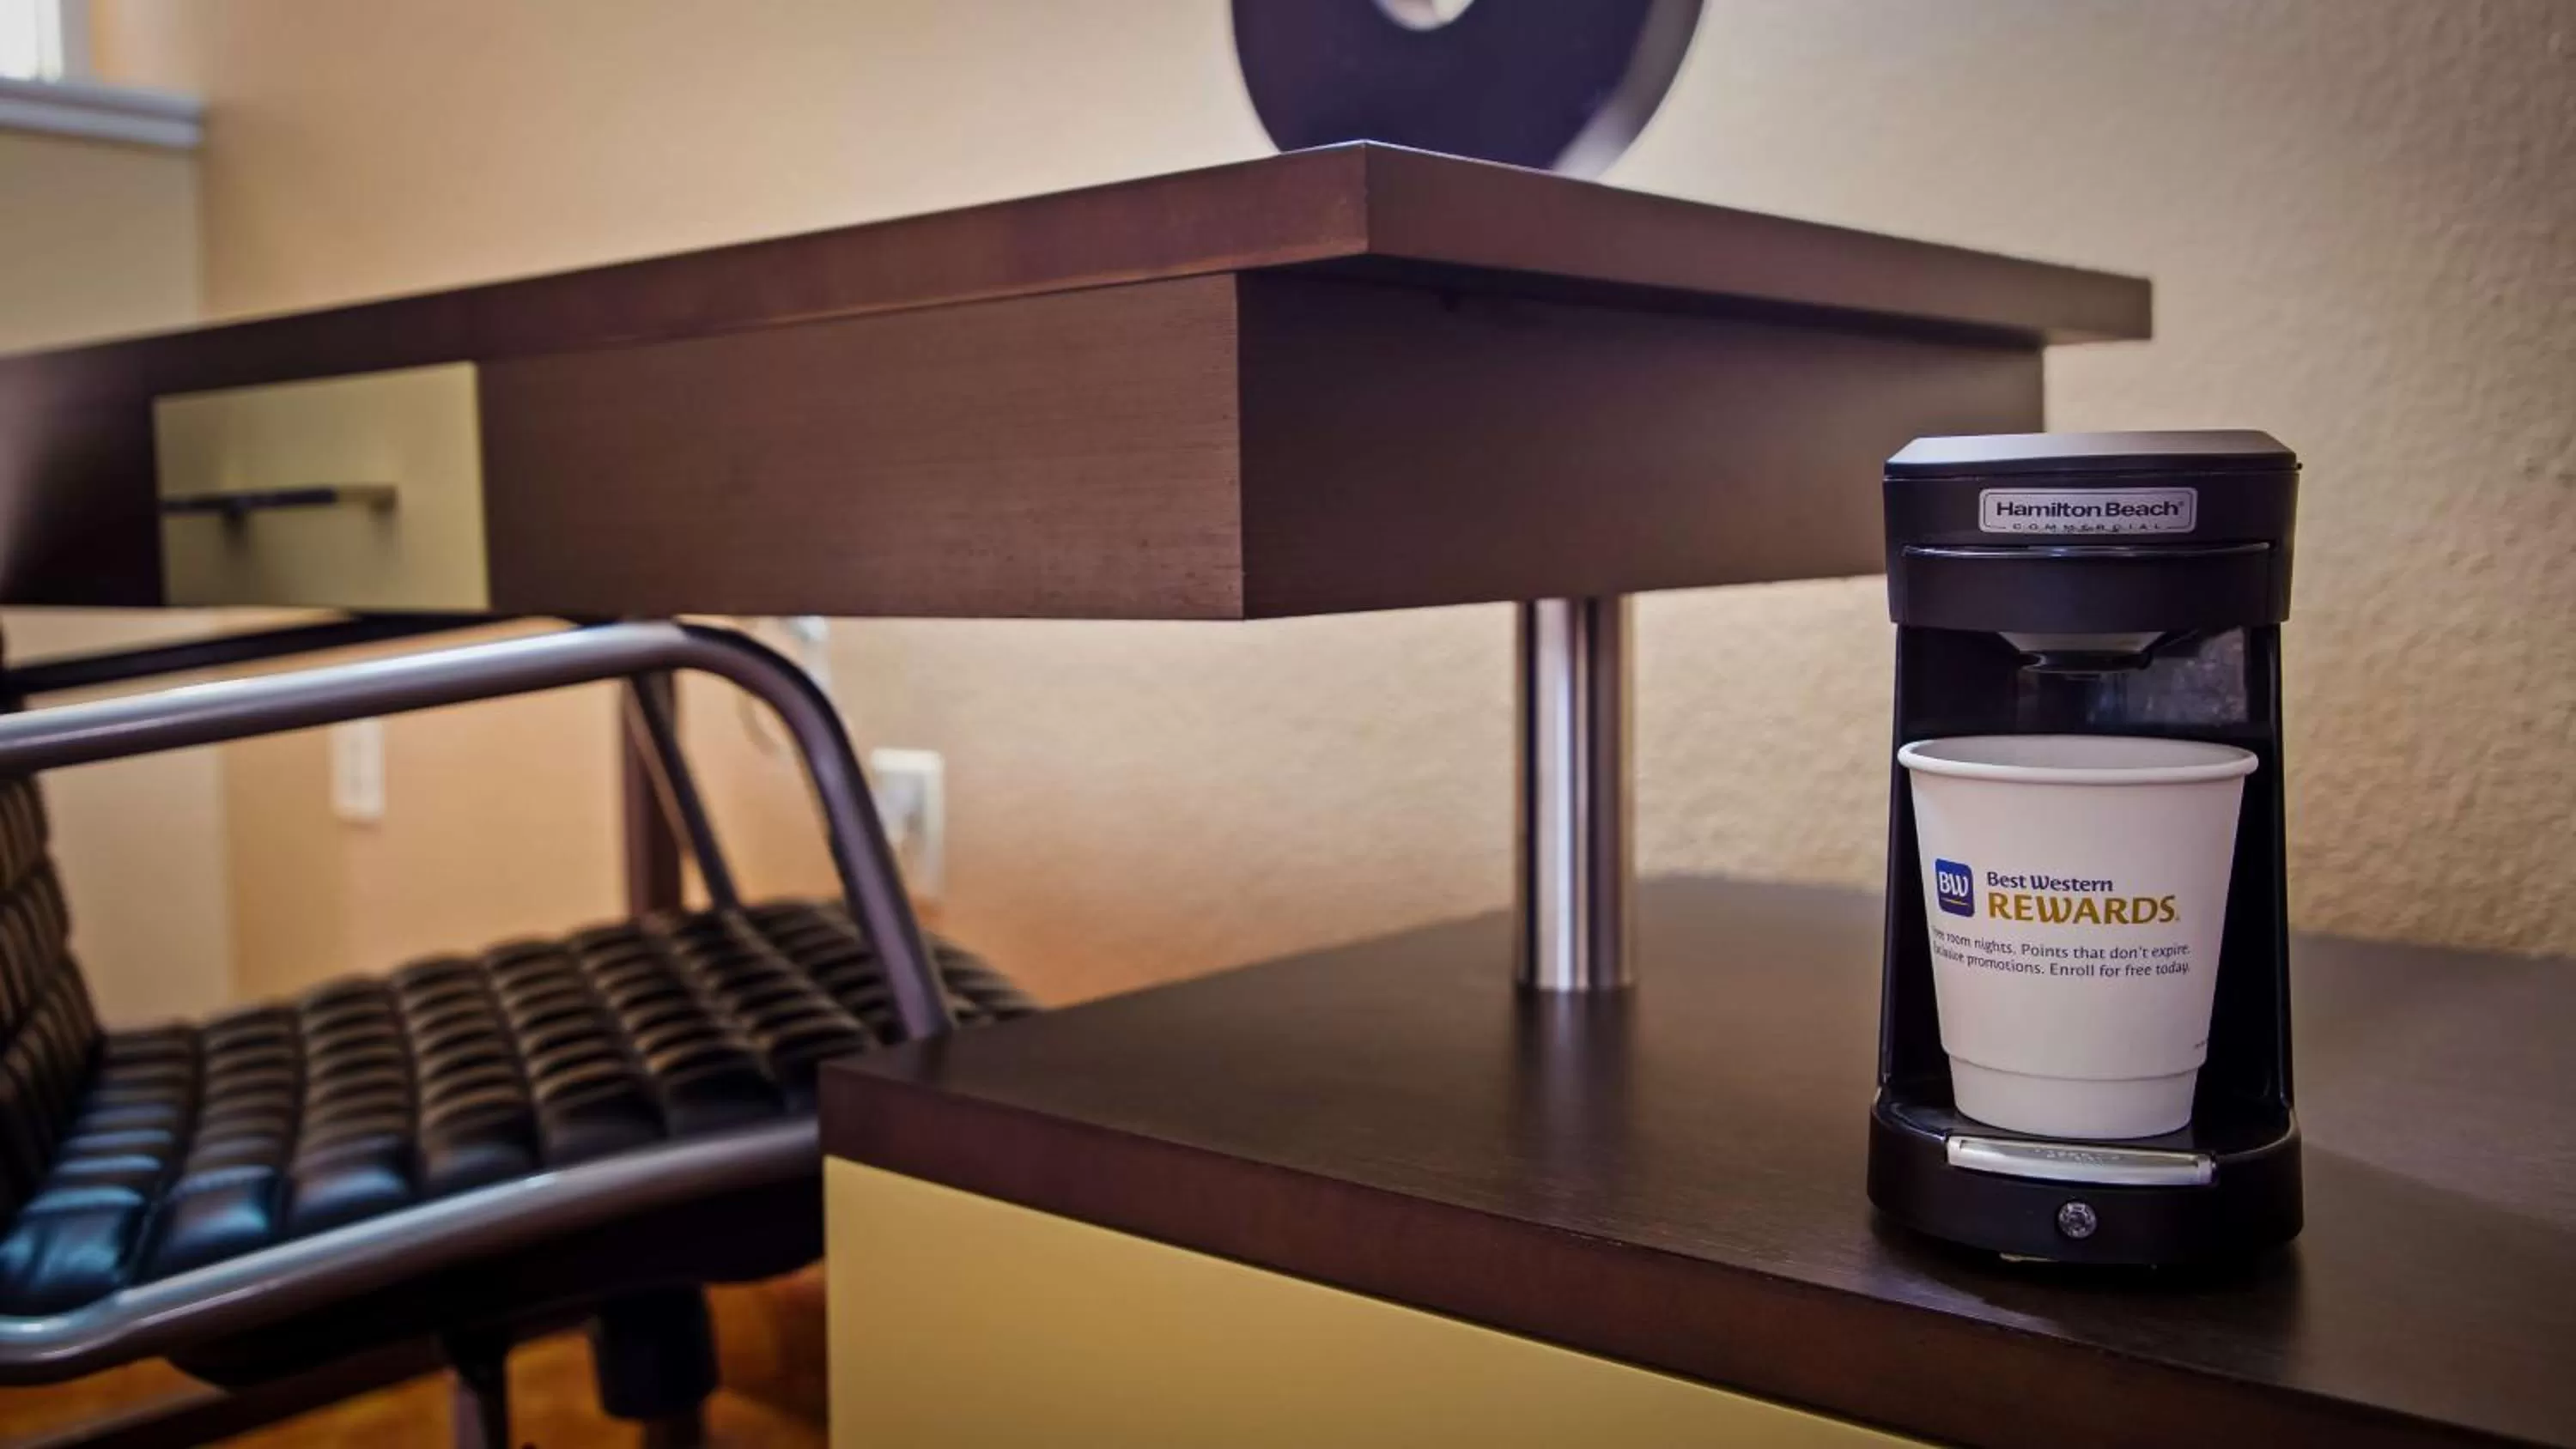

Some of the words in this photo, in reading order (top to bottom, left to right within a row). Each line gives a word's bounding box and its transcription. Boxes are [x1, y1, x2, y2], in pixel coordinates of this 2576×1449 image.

[1996, 501, 2102, 517] Hamilton
[1939, 870, 1969, 896] BW
[1987, 871, 2026, 889] Best
[2030, 874, 2113, 892] Western
[1974, 937, 2016, 955] nights.
[2021, 943, 2069, 958] Points
[2074, 945, 2105, 959] that
[2110, 946, 2148, 959] don't
[1966, 955, 2044, 974] promotions.
[2050, 962, 2094, 976] Enroll
[2099, 964, 2121, 977] for
[2125, 963, 2152, 976] free
